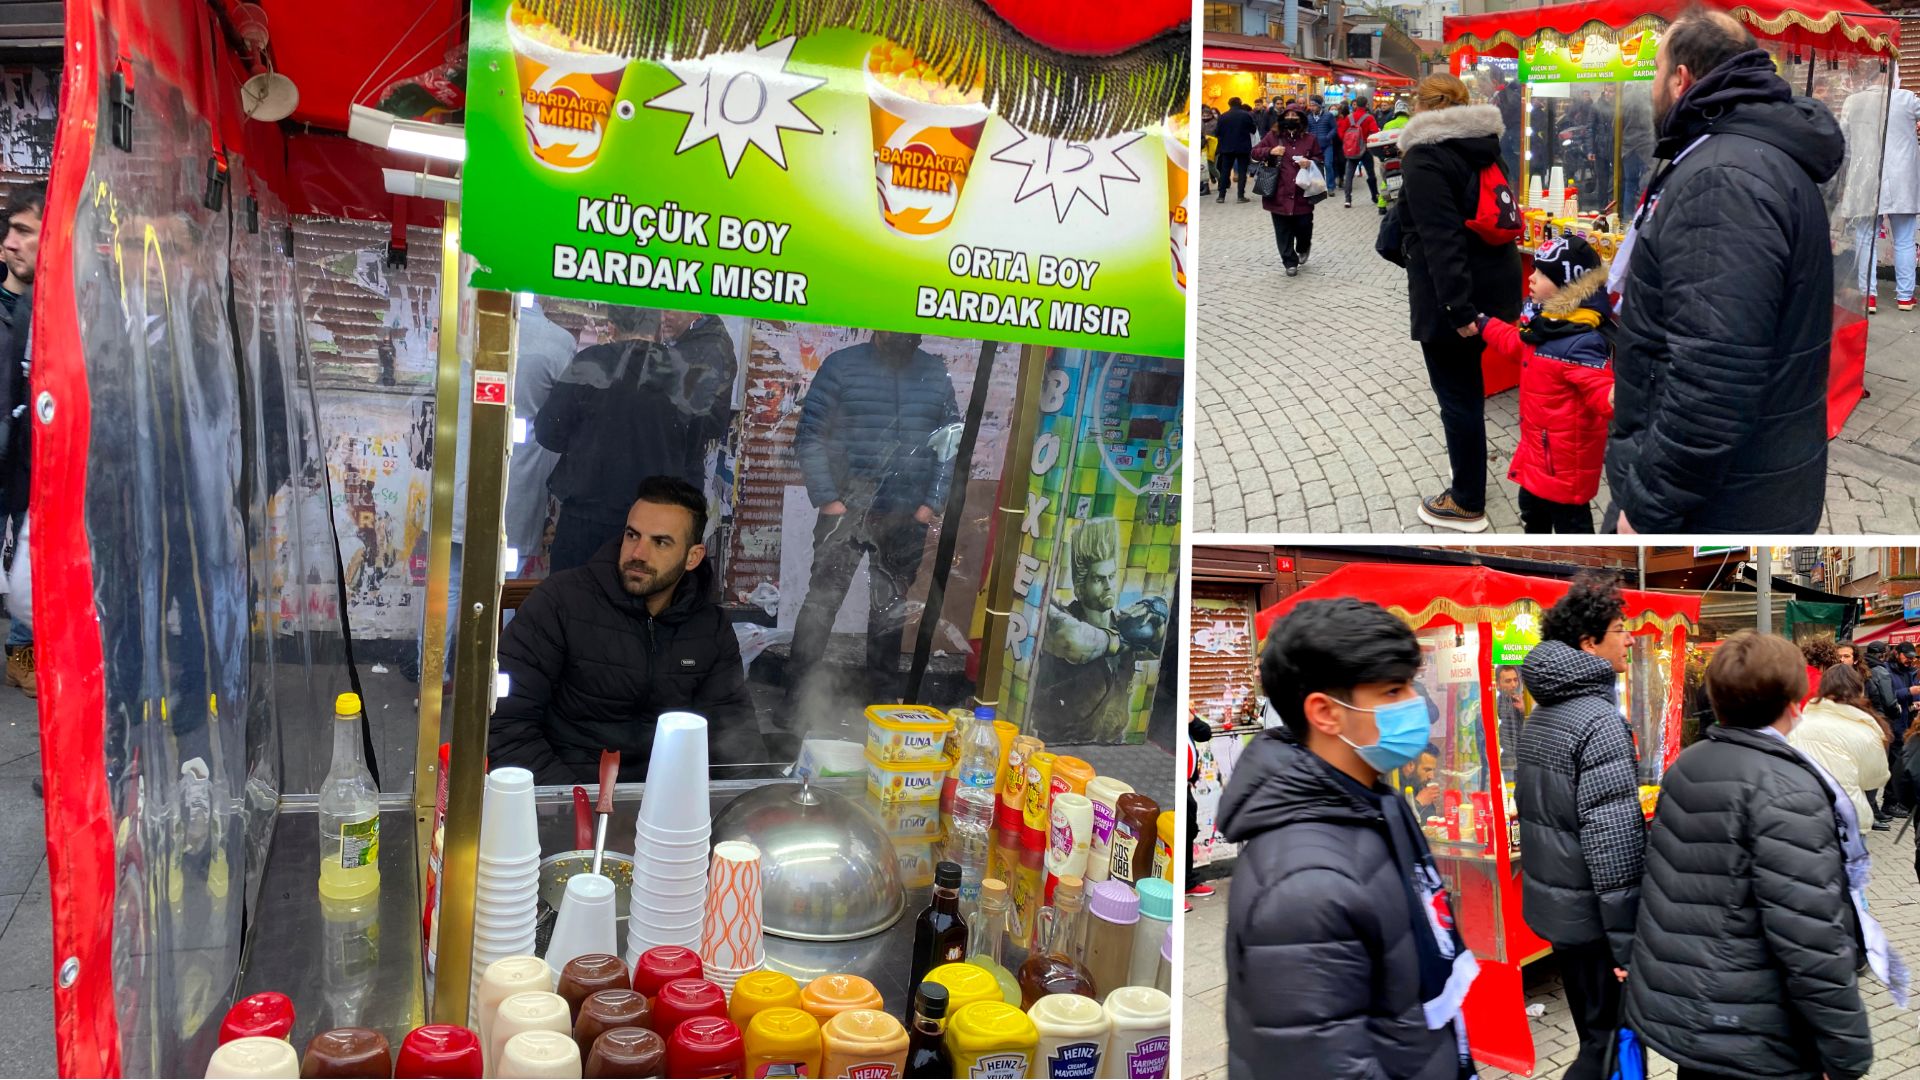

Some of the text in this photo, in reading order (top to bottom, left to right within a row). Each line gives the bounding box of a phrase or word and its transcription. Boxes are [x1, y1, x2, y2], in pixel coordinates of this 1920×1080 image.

[526, 89, 607, 114] BARDAKTA
[699, 67, 768, 128] 10
[540, 106, 594, 130] MISIR
[880, 148, 966, 173] BARDAKTA
[1046, 137, 1094, 174] 15
[892, 170, 949, 192] MISIR
[577, 194, 791, 255] KÜÇÜK BOY
[553, 244, 808, 305] BARDAK MISIR
[949, 244, 1099, 290] ORTA BOY
[916, 286, 1130, 338] BARDAK MISIR
[1005, 369, 1069, 661] BOXER
[904, 736, 931, 746] LUNA
[905, 777, 931, 787] LUNA
[1063, 1047, 1095, 1060] HEINZ
[1141, 1041, 1168, 1055] HEINZ
[855, 1069, 888, 1079] HEINZ
[987, 1060, 1018, 1071] HEINZ
[1054, 1066, 1095, 1078] MAYONNAISE
[1067, 1062, 1088, 1070] CREAMY
